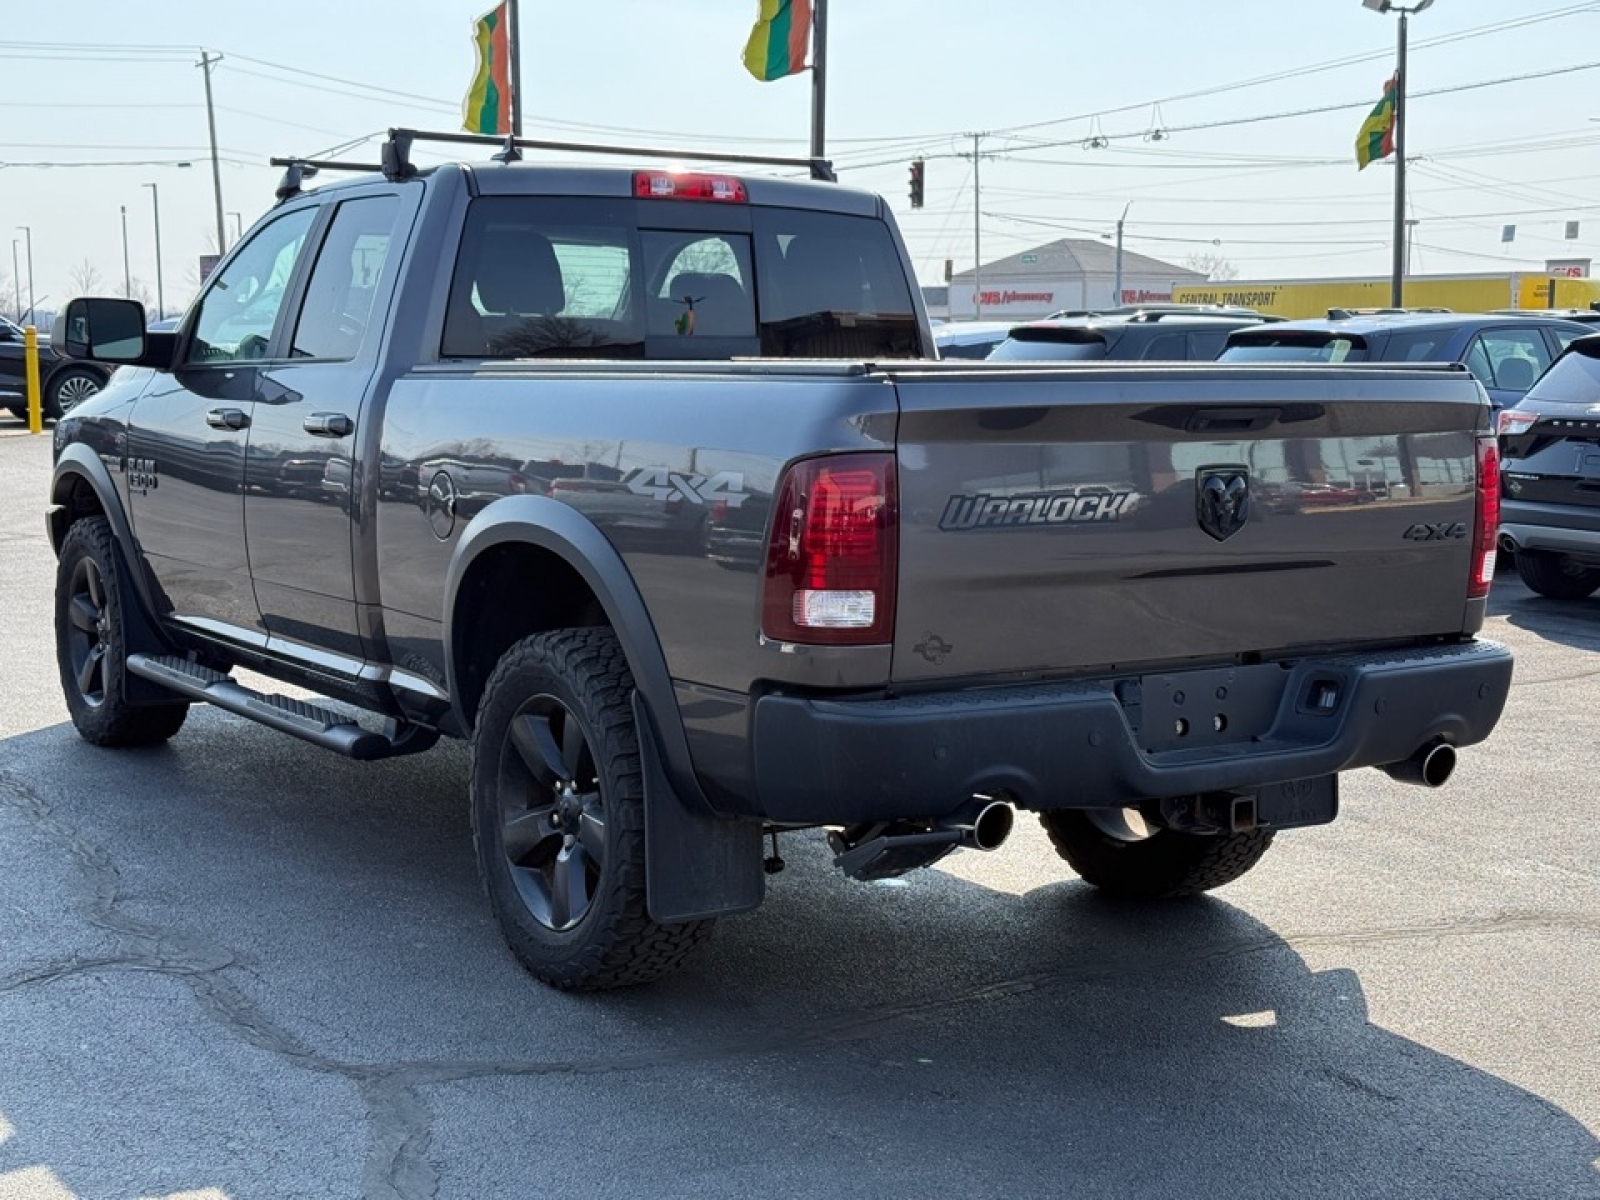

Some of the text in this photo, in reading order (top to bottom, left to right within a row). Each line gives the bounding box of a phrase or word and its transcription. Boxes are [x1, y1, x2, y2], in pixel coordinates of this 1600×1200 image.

[1180, 291, 1276, 306] CENTRAL TRANSPORT
[938, 493, 1131, 531] WARLOCK
[1402, 521, 1467, 541] 4X4
